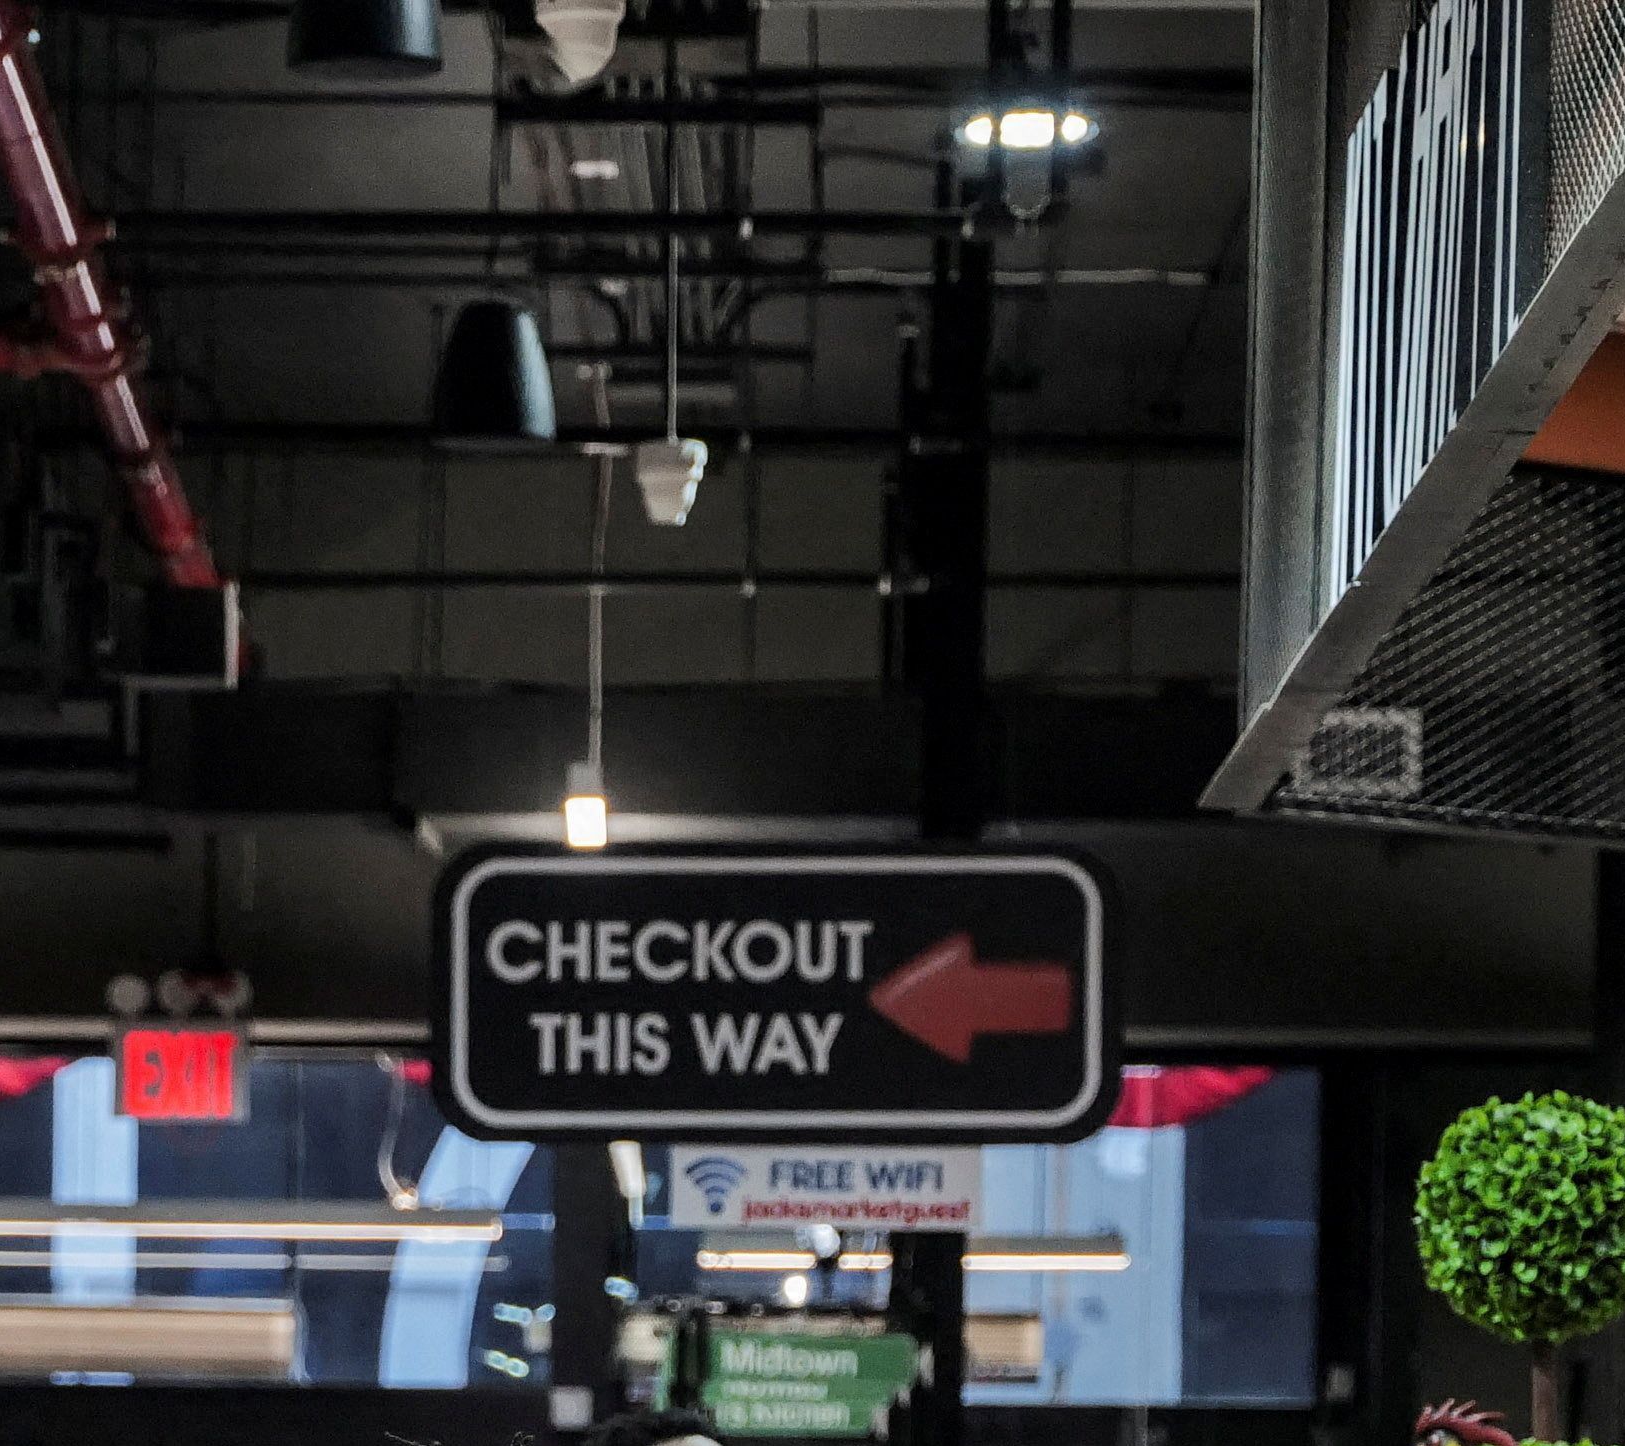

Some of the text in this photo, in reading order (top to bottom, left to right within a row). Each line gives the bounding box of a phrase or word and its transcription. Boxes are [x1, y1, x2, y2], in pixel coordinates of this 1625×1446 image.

[485, 919, 874, 984] CHECKOUT
[123, 1030, 238, 1119] EXIT
[530, 1013, 845, 1076] THIS WAY
[768, 1158, 944, 1193] FREE WIFI
[720, 1339, 859, 1379] Midtown
